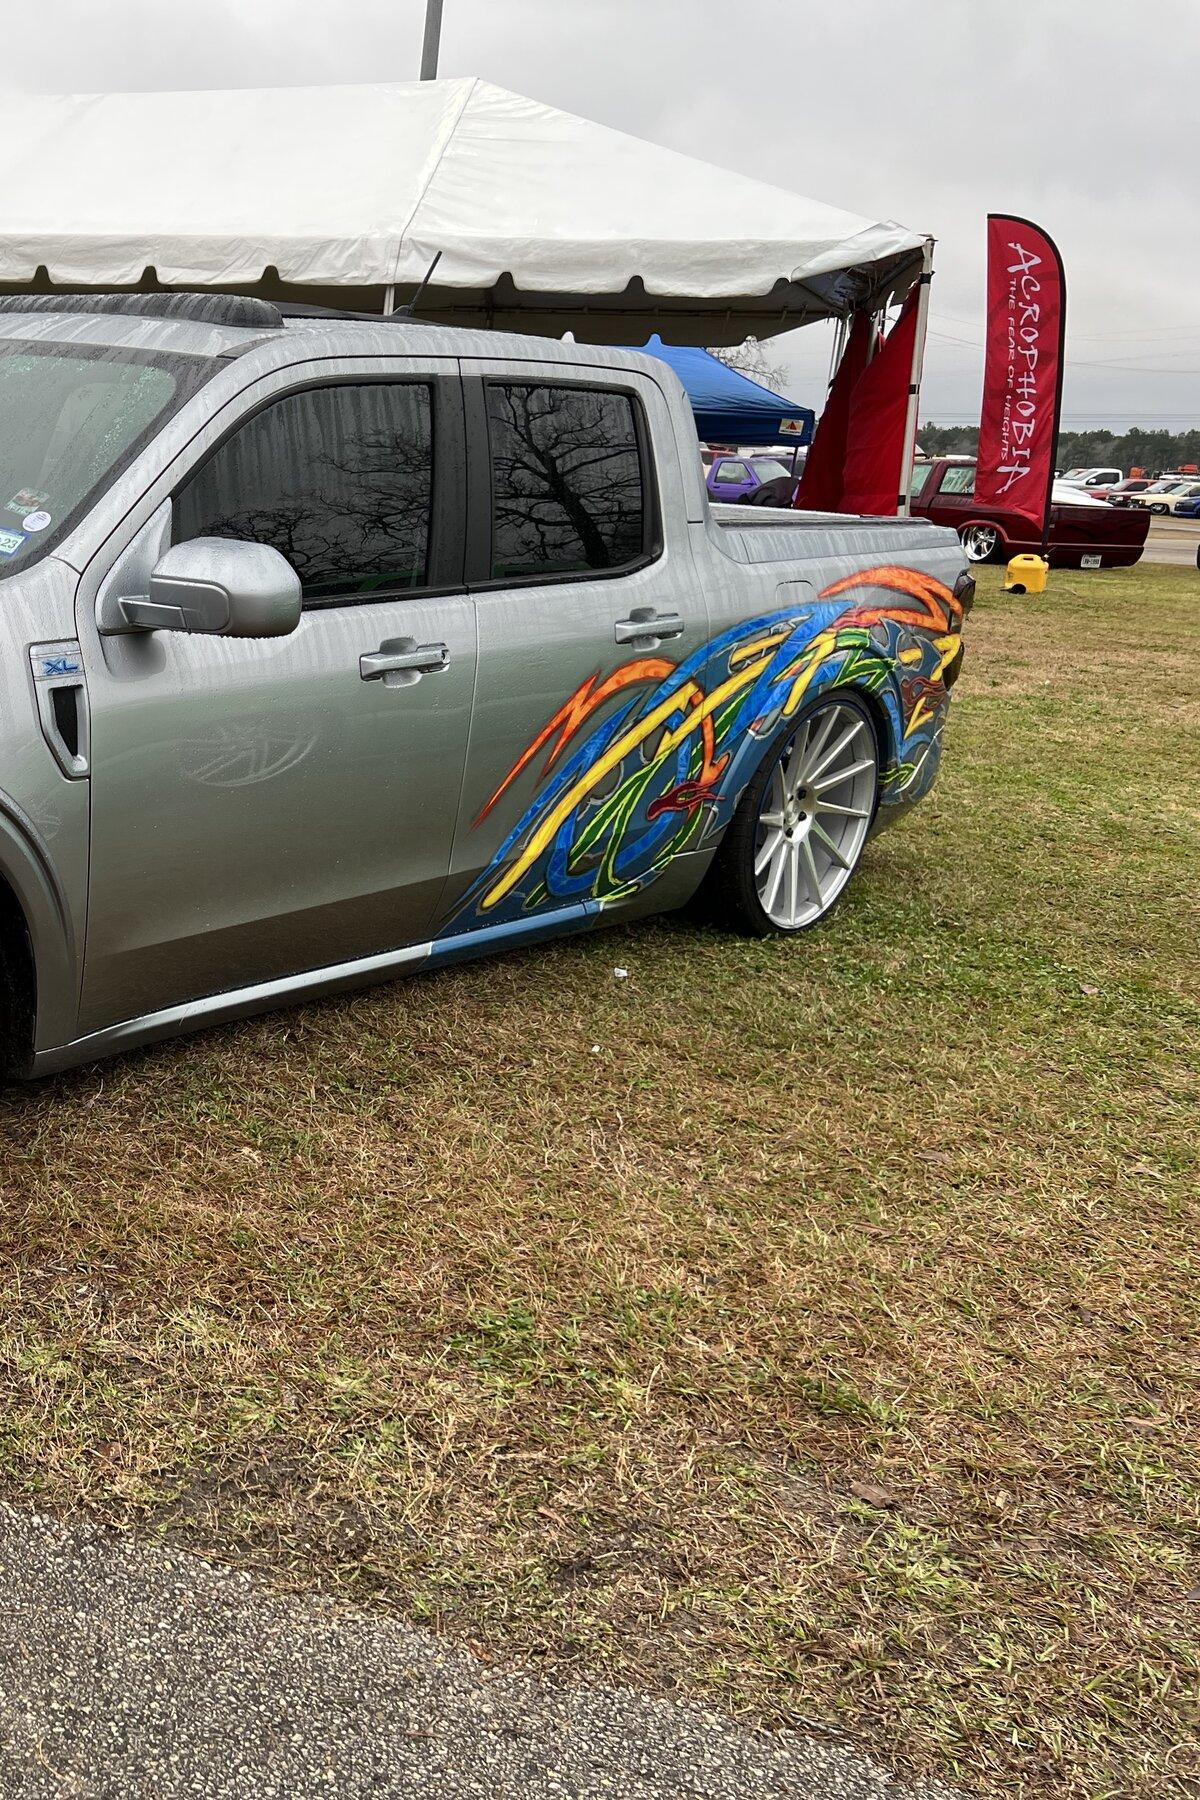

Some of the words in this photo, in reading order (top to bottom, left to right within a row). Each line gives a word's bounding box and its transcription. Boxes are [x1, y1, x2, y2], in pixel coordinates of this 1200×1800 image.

[1008, 278, 1017, 310] THE
[1007, 317, 1016, 361] FEAR
[995, 242, 1042, 494] ACROPHOBIA
[1007, 365, 1015, 388] OF
[1001, 395, 1012, 461] HEIGHTS
[42, 656, 79, 676] XL
